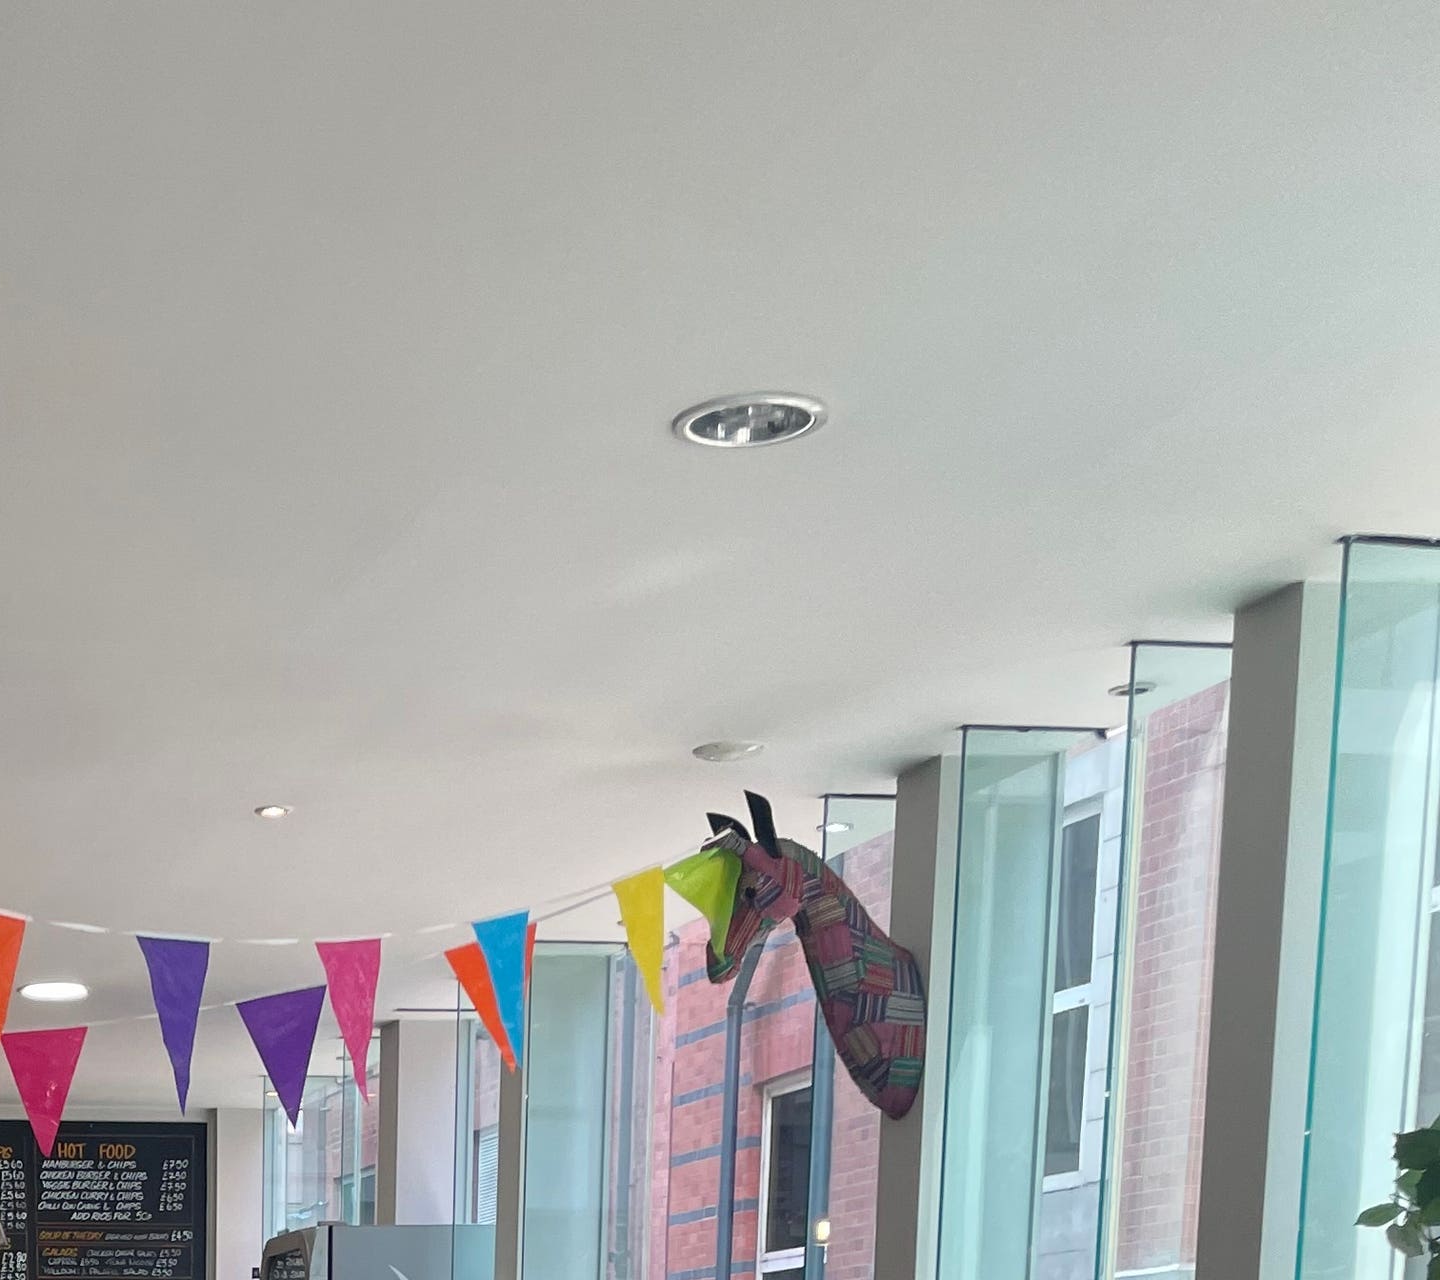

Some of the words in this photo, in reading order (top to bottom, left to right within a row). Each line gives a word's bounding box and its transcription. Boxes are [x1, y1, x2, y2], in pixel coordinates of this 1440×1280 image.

[58, 1143, 86, 1159] HOT
[100, 1144, 136, 1159] FOOD
[42, 1160, 94, 1169] HAMBURGER
[107, 1160, 136, 1169] CHIPS
[40, 1171, 74, 1179] CHICKEN
[76, 1171, 111, 1180] BURGER
[121, 1171, 148, 1180] CHIPS
[116, 1181, 142, 1190] CHIPS
[41, 1191, 79, 1200] CHICKEN
[116, 1191, 144, 1200] CHIPS
[70, 1212, 90, 1221] ADD
